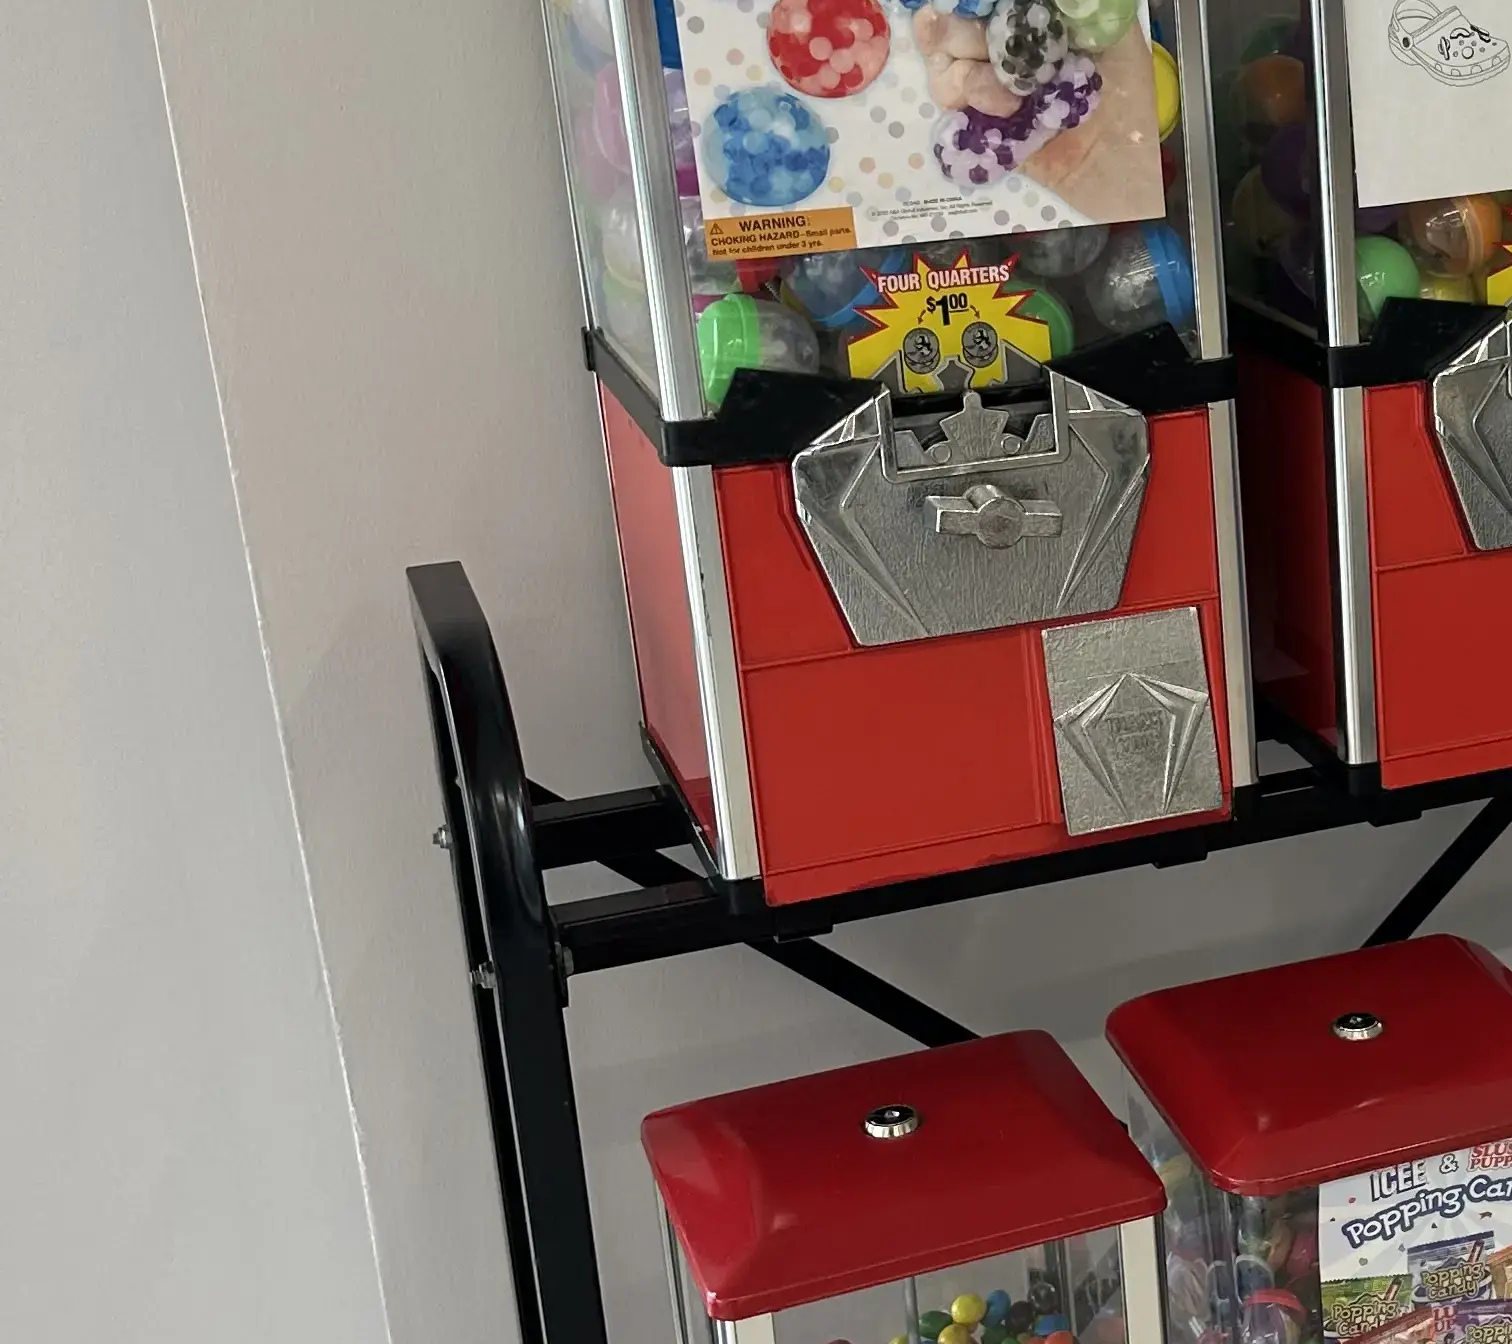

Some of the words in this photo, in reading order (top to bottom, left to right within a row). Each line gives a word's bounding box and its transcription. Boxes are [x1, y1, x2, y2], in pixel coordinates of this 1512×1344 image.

[711, 234, 757, 246] CHOKING
[877, 273, 921, 293] FOUR
[928, 265, 1010, 292] QUARTERS
[1370, 1158, 1429, 1202] ICEE
[1439, 1153, 1460, 1174] &
[1345, 1183, 1464, 1246] Popping
[1422, 1261, 1485, 1287] Popping
[1428, 1278, 1478, 1299] Candy
[1333, 1300, 1397, 1322] Popping
[1338, 1317, 1379, 1335] Cand
